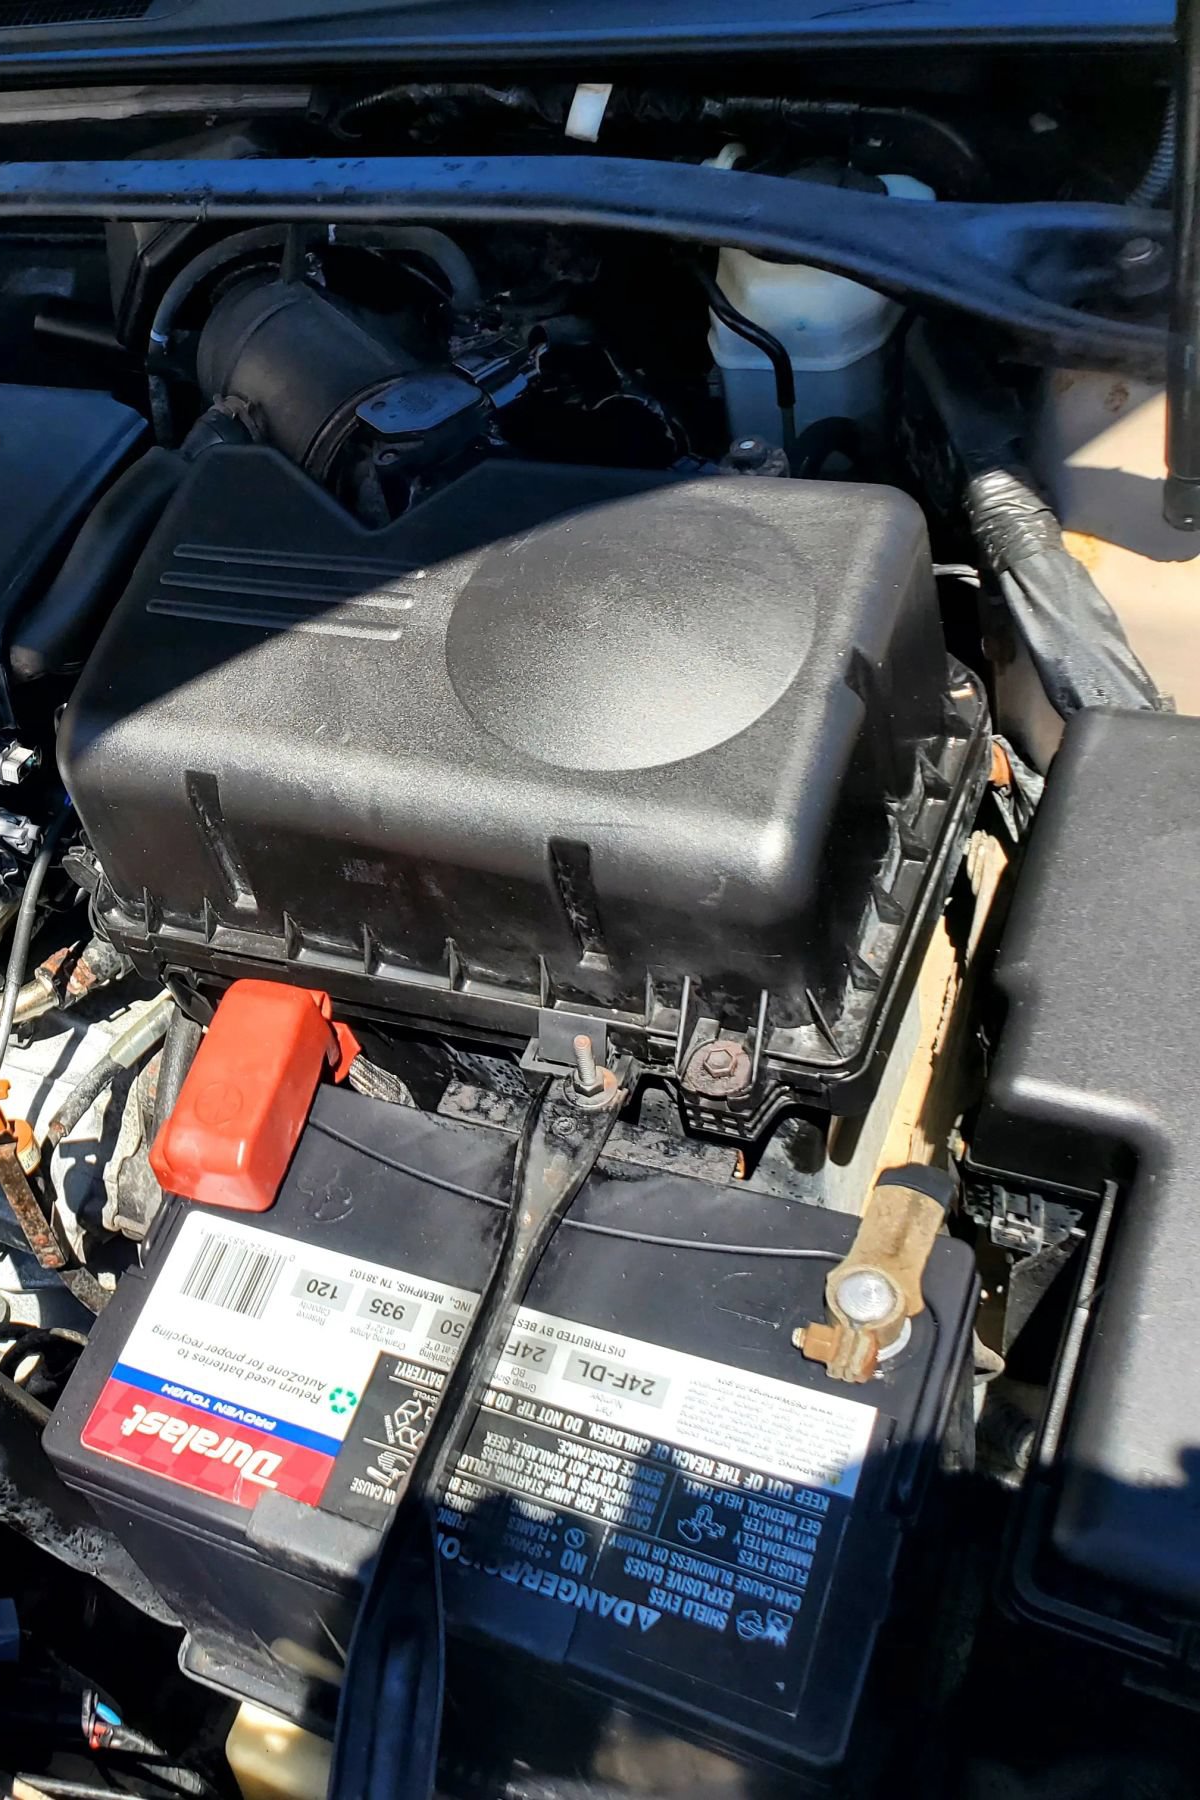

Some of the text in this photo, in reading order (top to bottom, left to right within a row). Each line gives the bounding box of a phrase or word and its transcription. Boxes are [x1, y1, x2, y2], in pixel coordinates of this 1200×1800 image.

[305, 1277, 339, 1300] 120
[349, 1267, 378, 1284] 38103
[379, 1276, 393, 1288] TN
[394, 1280, 444, 1303] MEMPHIS,
[295, 1309, 325, 1326] Reserve
[368, 1297, 405, 1321] 935
[348, 1325, 406, 1350] Cranking Amps
[385, 1327, 394, 1337] at
[538, 1324, 554, 1336] BY
[555, 1329, 625, 1357] DISTRIBUTED
[150, 1323, 327, 1392] AutoZone for proper recycling
[440, 1344, 450, 1355] at
[176, 1346, 321, 1405] Return used batteries to
[393, 1360, 445, 1389] BATTERY!
[512, 1377, 537, 1392] Group
[574, 1358, 656, 1397] 24F-DL
[160, 1381, 276, 1431] PROVEN TOUGH
[493, 1392, 513, 1411] DO
[514, 1398, 536, 1418] TIP.
[536, 1405, 563, 1427] NOT
[562, 1414, 583, 1433] DO
[119, 1401, 285, 1488] Duralast
[585, 1421, 651, 1454] CHILDREN.
[652, 1442, 670, 1460] OF
[483, 1430, 661, 1500] MANUAL OR IF NOT AVAILABLE, SEEK
[554, 1437, 666, 1485] SERVICE ASSISTANCE.
[670, 1447, 715, 1474] REACH
[713, 1461, 743, 1483] THE
[349, 1476, 384, 1500] CAUSE
[456, 1453, 652, 1530] CAUTION: FOR JUMP STARTING, FOLLO
[480, 1444, 657, 1514] INSTRUCTIONS IN VEHICLE OWNERS
[742, 1470, 765, 1490] OF
[763, 1476, 794, 1499] OUT
[508, 1497, 556, 1526] SMOKING
[679, 1478, 822, 1535] GET MEDICAL HELP FAST.
[794, 1486, 830, 1511] KEEP
[506, 1515, 550, 1542] FLAMES
[738, 1513, 818, 1550] WITH WATER.
[558, 1547, 588, 1575] NO
[731, 1529, 813, 1568] IMMEDIATELY
[608, 1531, 802, 1610] CAN CAUSE BLINDNESS OR INJURY
[736, 1548, 809, 1584] FLUSH EYES
[622, 1554, 735, 1609] EXPLOSIVE GASES
[646, 1586, 729, 1631] SHIELD EYES
